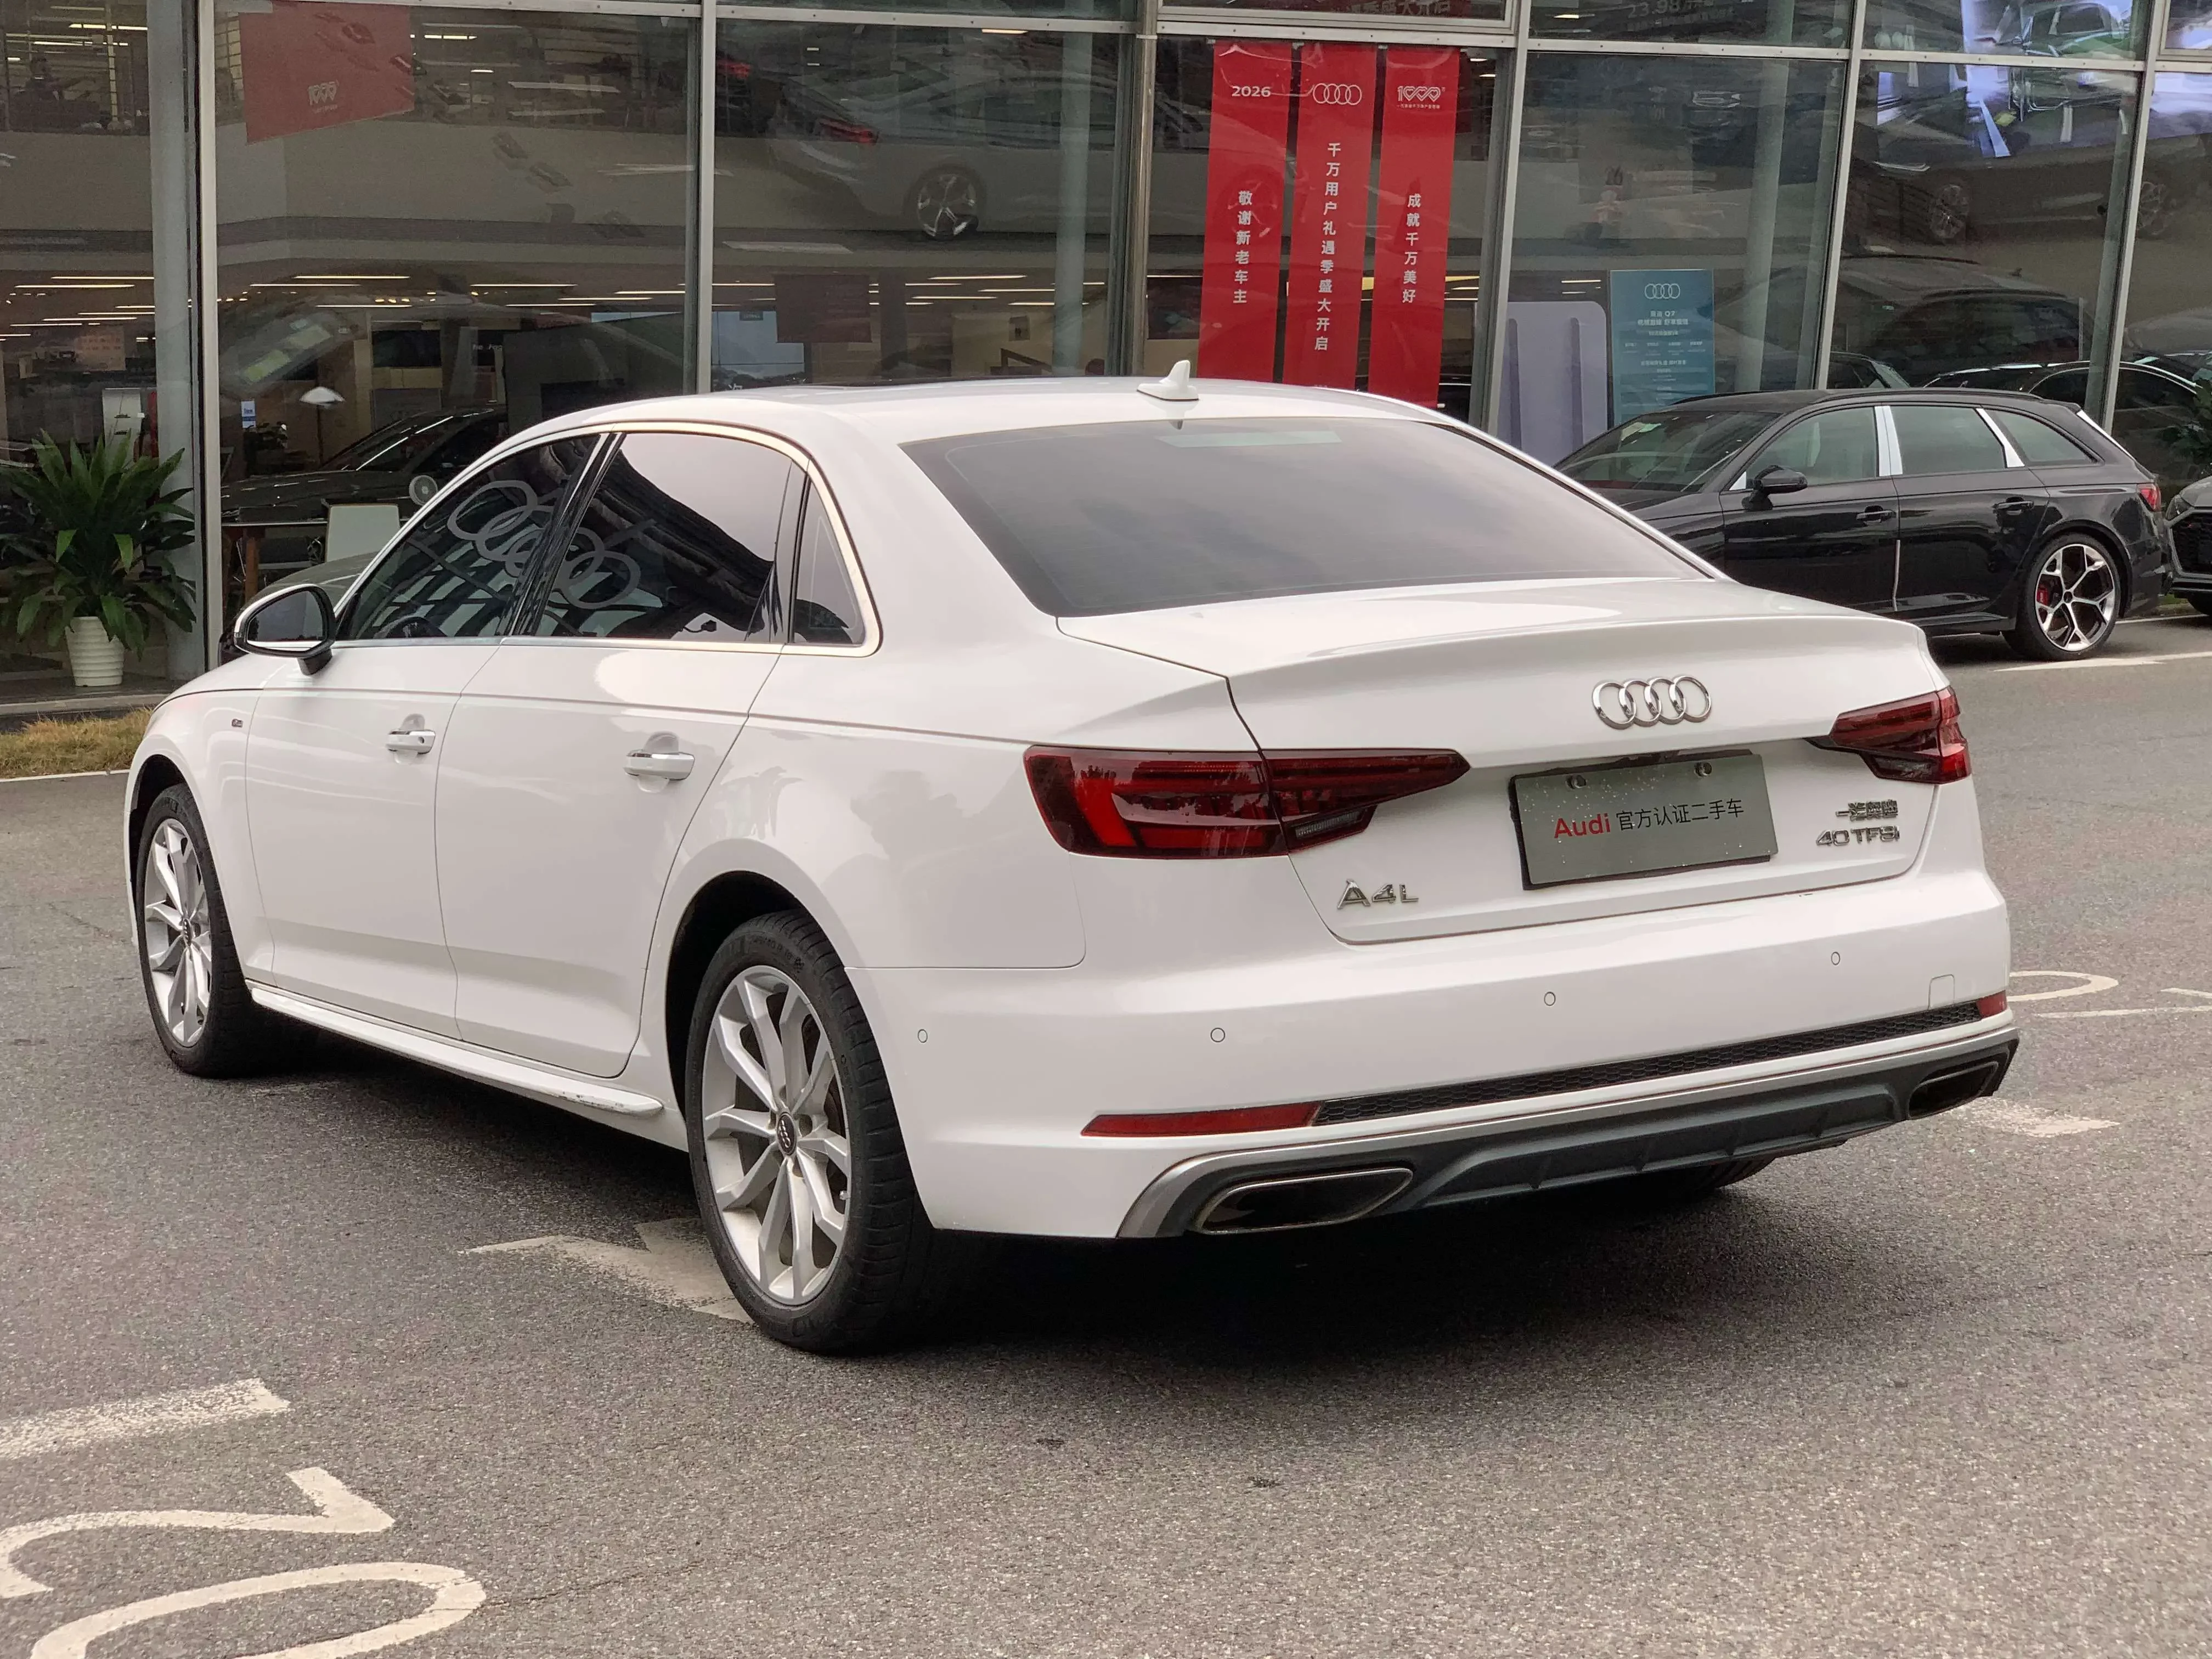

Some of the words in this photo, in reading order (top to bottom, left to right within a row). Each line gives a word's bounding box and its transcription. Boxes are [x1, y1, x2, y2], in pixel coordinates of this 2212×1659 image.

[1232, 86, 1272, 97] 2026
[1233, 190, 1253, 303] 敬谢新老车主
[1314, 142, 1341, 351] 千万用户礼遇季盛大开启
[1402, 193, 1422, 303] 成就千万美好
[1554, 812, 1611, 838] Audi
[1616, 798, 1745, 831] 官方认证二手车
[1815, 829, 1850, 846] 40
[1337, 879, 1419, 909] A4L
